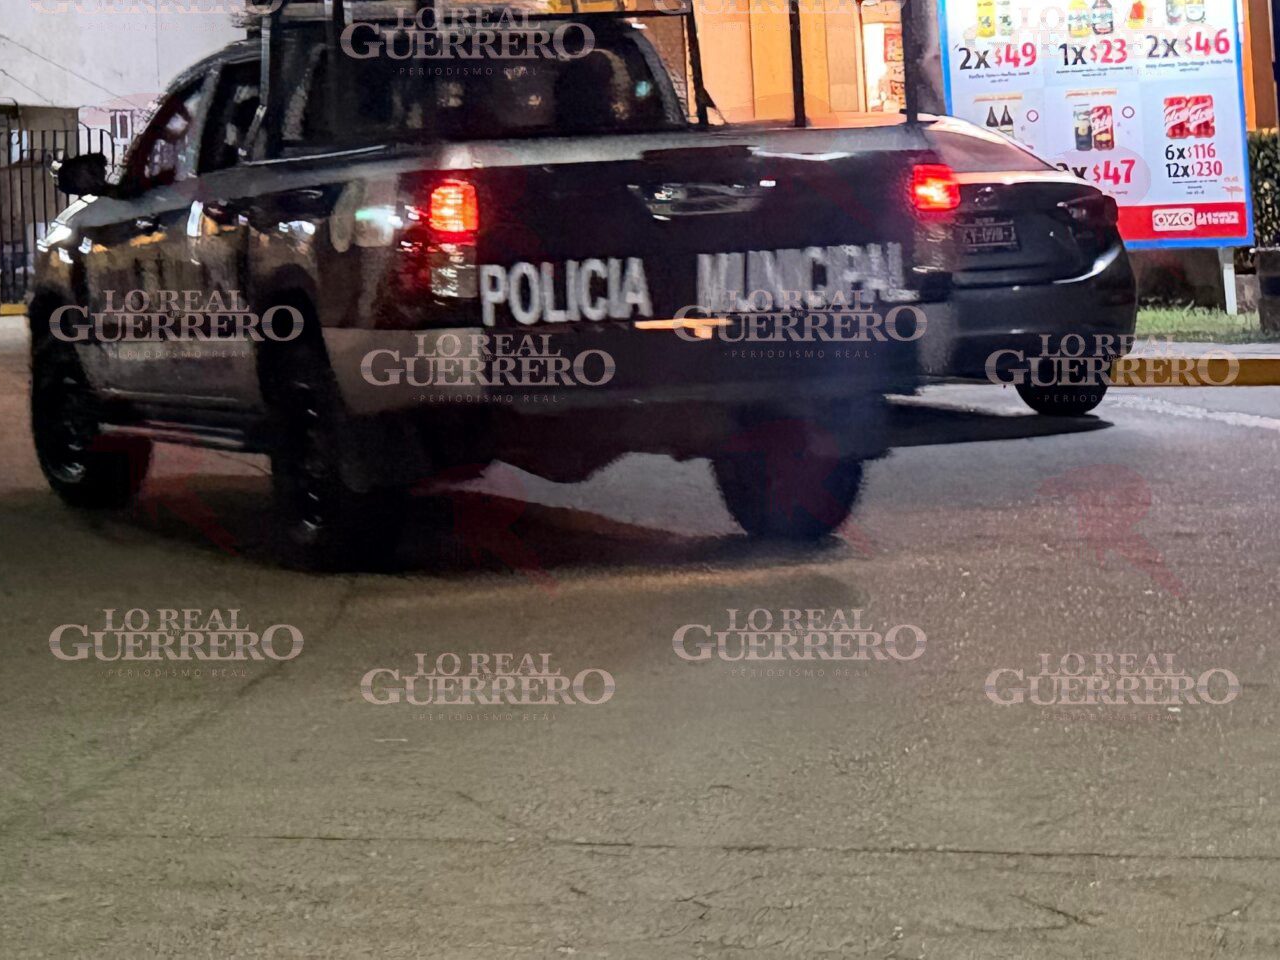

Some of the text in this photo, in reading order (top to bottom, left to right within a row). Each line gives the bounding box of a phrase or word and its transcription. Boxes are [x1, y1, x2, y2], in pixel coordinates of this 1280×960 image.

[995, 42, 1037, 68] $49
[1090, 39, 1128, 64] $23
[1185, 29, 1231, 55] $46
[1093, 159, 1136, 185] $47
[480, 257, 653, 328] POLICIA
